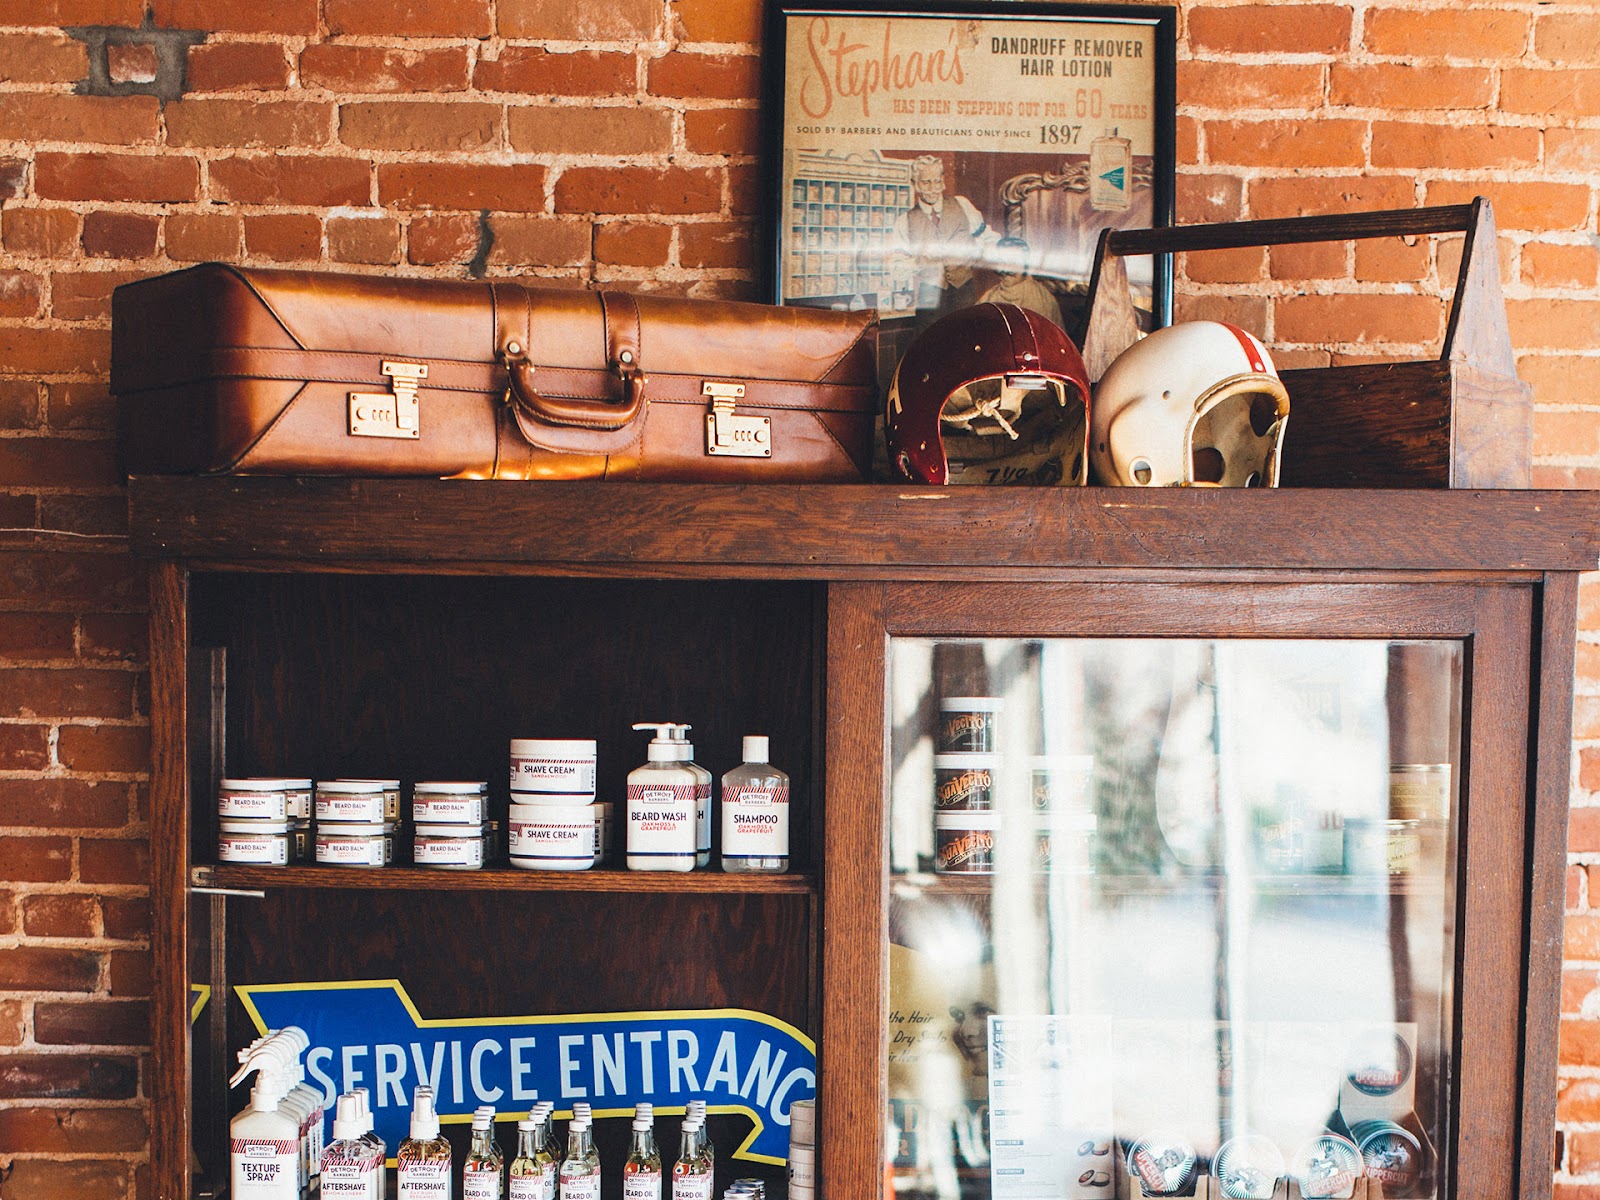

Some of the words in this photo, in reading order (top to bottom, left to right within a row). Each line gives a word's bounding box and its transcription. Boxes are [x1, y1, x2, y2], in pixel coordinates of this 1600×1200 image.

[991, 36, 1067, 56] DANDRUFF
[1074, 40, 1143, 59] REMOVER
[800, 17, 965, 119] Stephan's
[1020, 58, 1053, 76] HAIR
[1062, 60, 1112, 78] LOTION
[893, 99, 916, 115] HAS
[919, 99, 951, 115] BEEN
[957, 100, 1014, 117] STEPPING
[1018, 101, 1041, 117] OUT
[1044, 102, 1067, 118] FOR
[1075, 88, 1102, 119] 60
[1109, 103, 1148, 120] YEARS
[796, 126, 822, 135] SOLD
[825, 127, 837, 135] BY
[840, 127, 882, 136] BARBERS
[886, 127, 907, 136] AND
[910, 128, 973, 137] BEAUTICIANS
[976, 129, 1001, 138] ONLY
[1003, 130, 1032, 139] SINCE
[1039, 124, 1082, 145] 1897
[524, 765, 547, 774] SHAVE
[548, 766, 575, 774] CREAM
[631, 812, 660, 821] BEARD
[661, 812, 686, 821] WASH
[733, 814, 778, 824] SHAMPOO
[527, 830, 550, 839] SHAVE
[552, 831, 578, 839] CREAM
[908, 1011, 934, 1023] Hair
[893, 1030, 916, 1047] Dry
[307, 1037, 538, 1111] SERVICE
[559, 1030, 815, 1125] ENTRANC
[241, 1163, 280, 1173] TEXTURE
[247, 1173, 275, 1181] SPRAY
[322, 1183, 366, 1191] AFTERSHAVE
[464, 1189, 480, 1197] BEARD
[510, 1191, 526, 1200] BEARD
[565, 1192, 585, 1200] BEARD
[675, 1190, 693, 1198] BEARD
